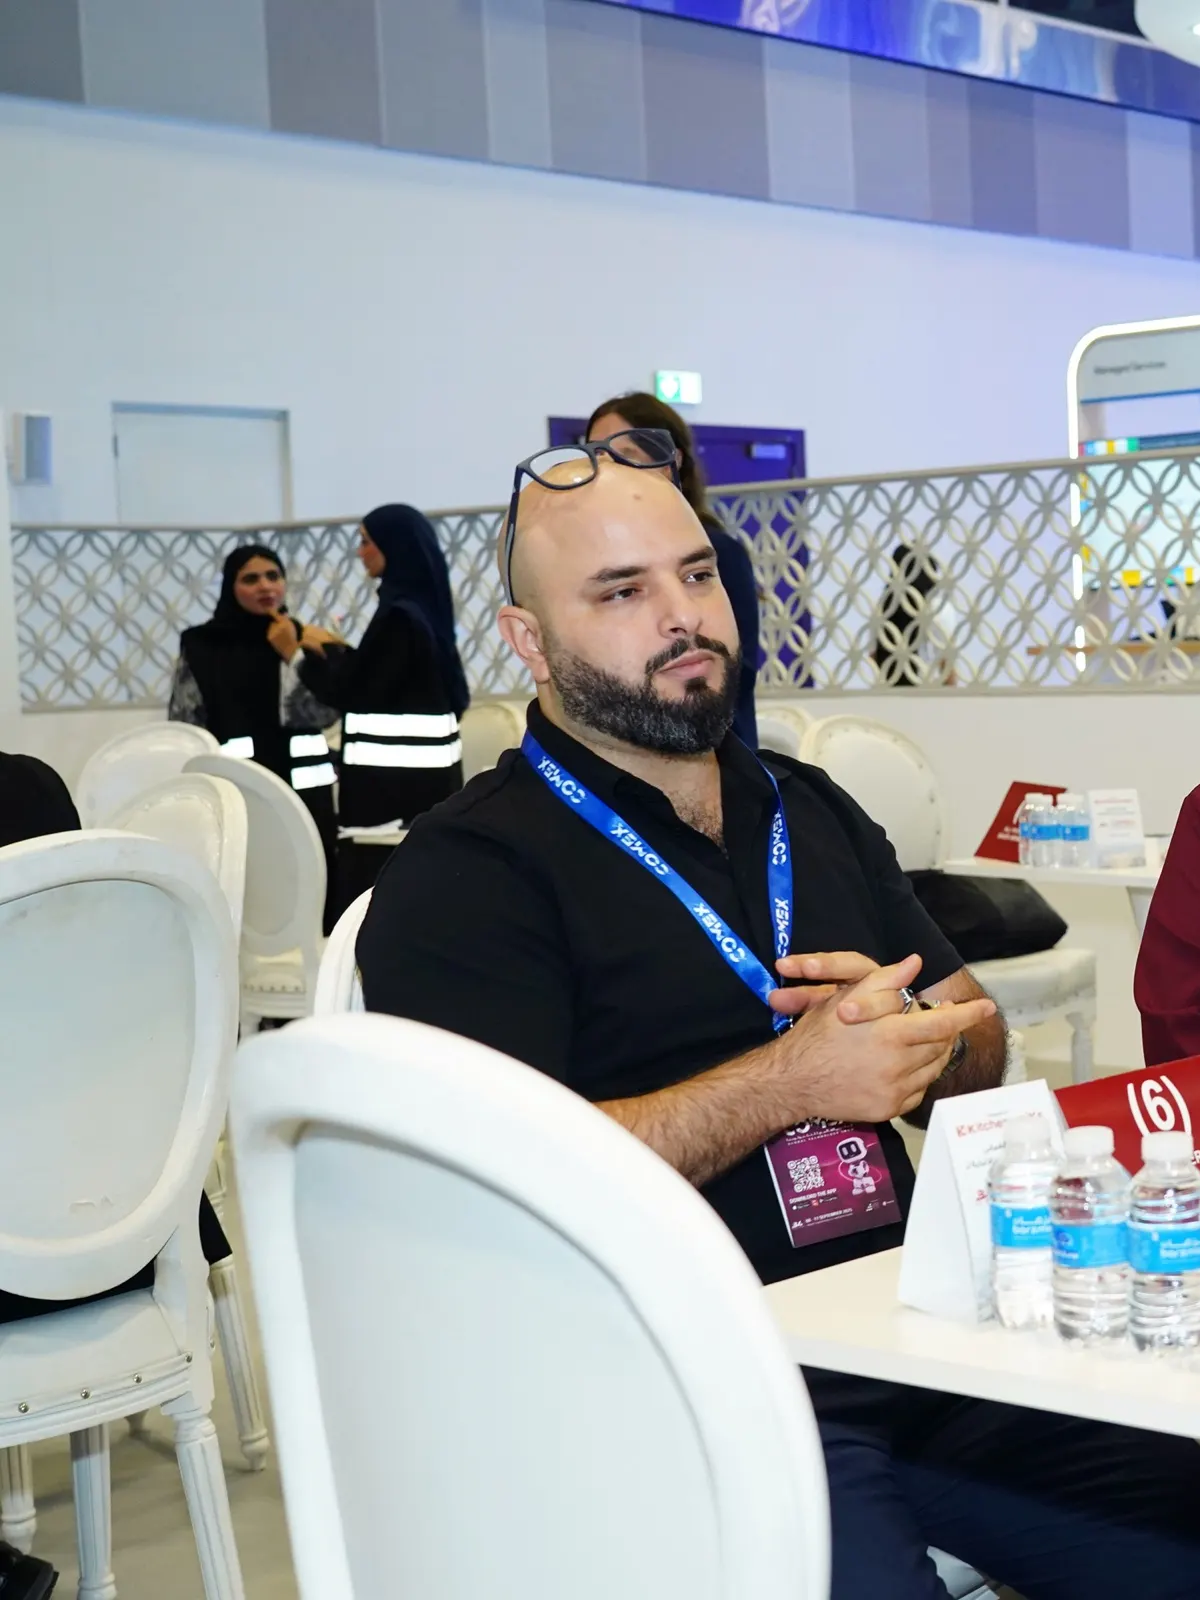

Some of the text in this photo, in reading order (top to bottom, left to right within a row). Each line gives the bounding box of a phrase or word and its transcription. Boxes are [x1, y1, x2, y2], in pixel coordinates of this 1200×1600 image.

[538, 756, 587, 803] COMEX
[610, 822, 670, 875] COMEX
[693, 902, 747, 963] COMEX
[1127, 1075, 1192, 1137] (6)
